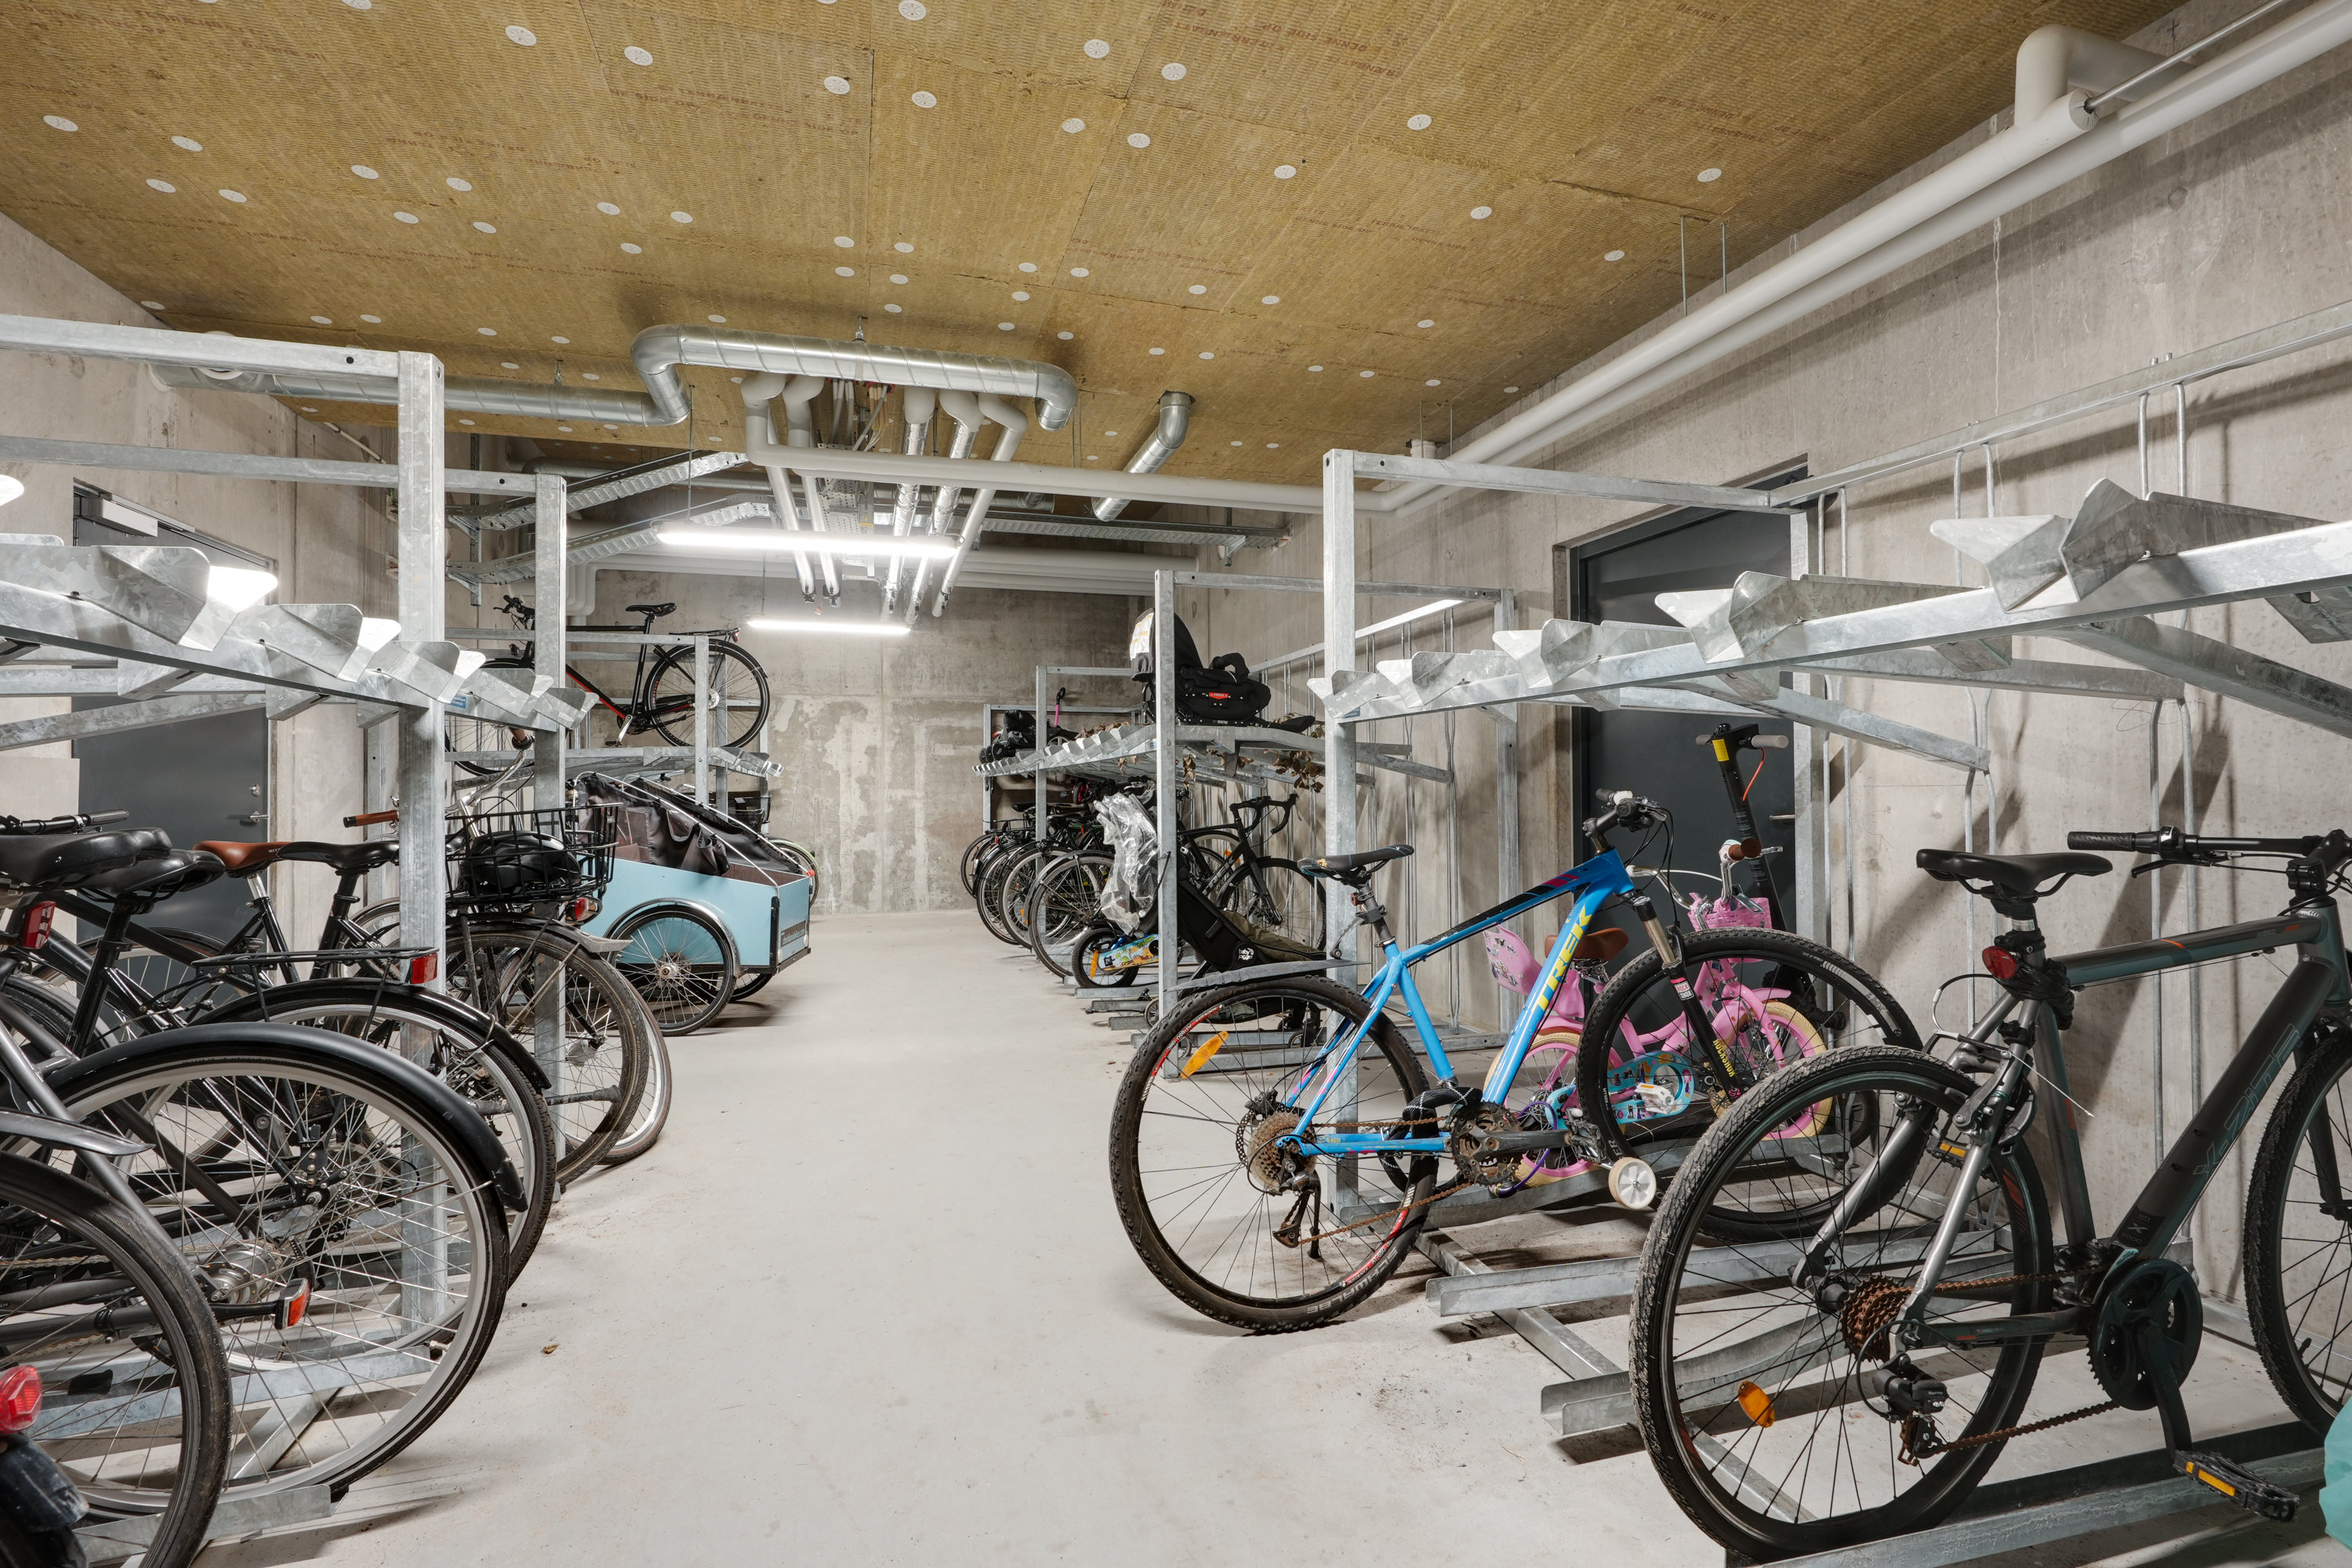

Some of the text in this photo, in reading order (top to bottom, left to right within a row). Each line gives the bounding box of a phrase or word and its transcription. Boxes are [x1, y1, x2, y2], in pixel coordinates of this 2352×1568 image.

[1323, 36, 1368, 52] DENNE
[1202, 855, 1236, 896] TREK
[1531, 904, 1593, 1013] TREK
[1676, 983, 1689, 993] ROCK
[1712, 1039, 1736, 1078] ROCKSHOX
[1306, 1246, 1399, 1315] SCHWALBE
